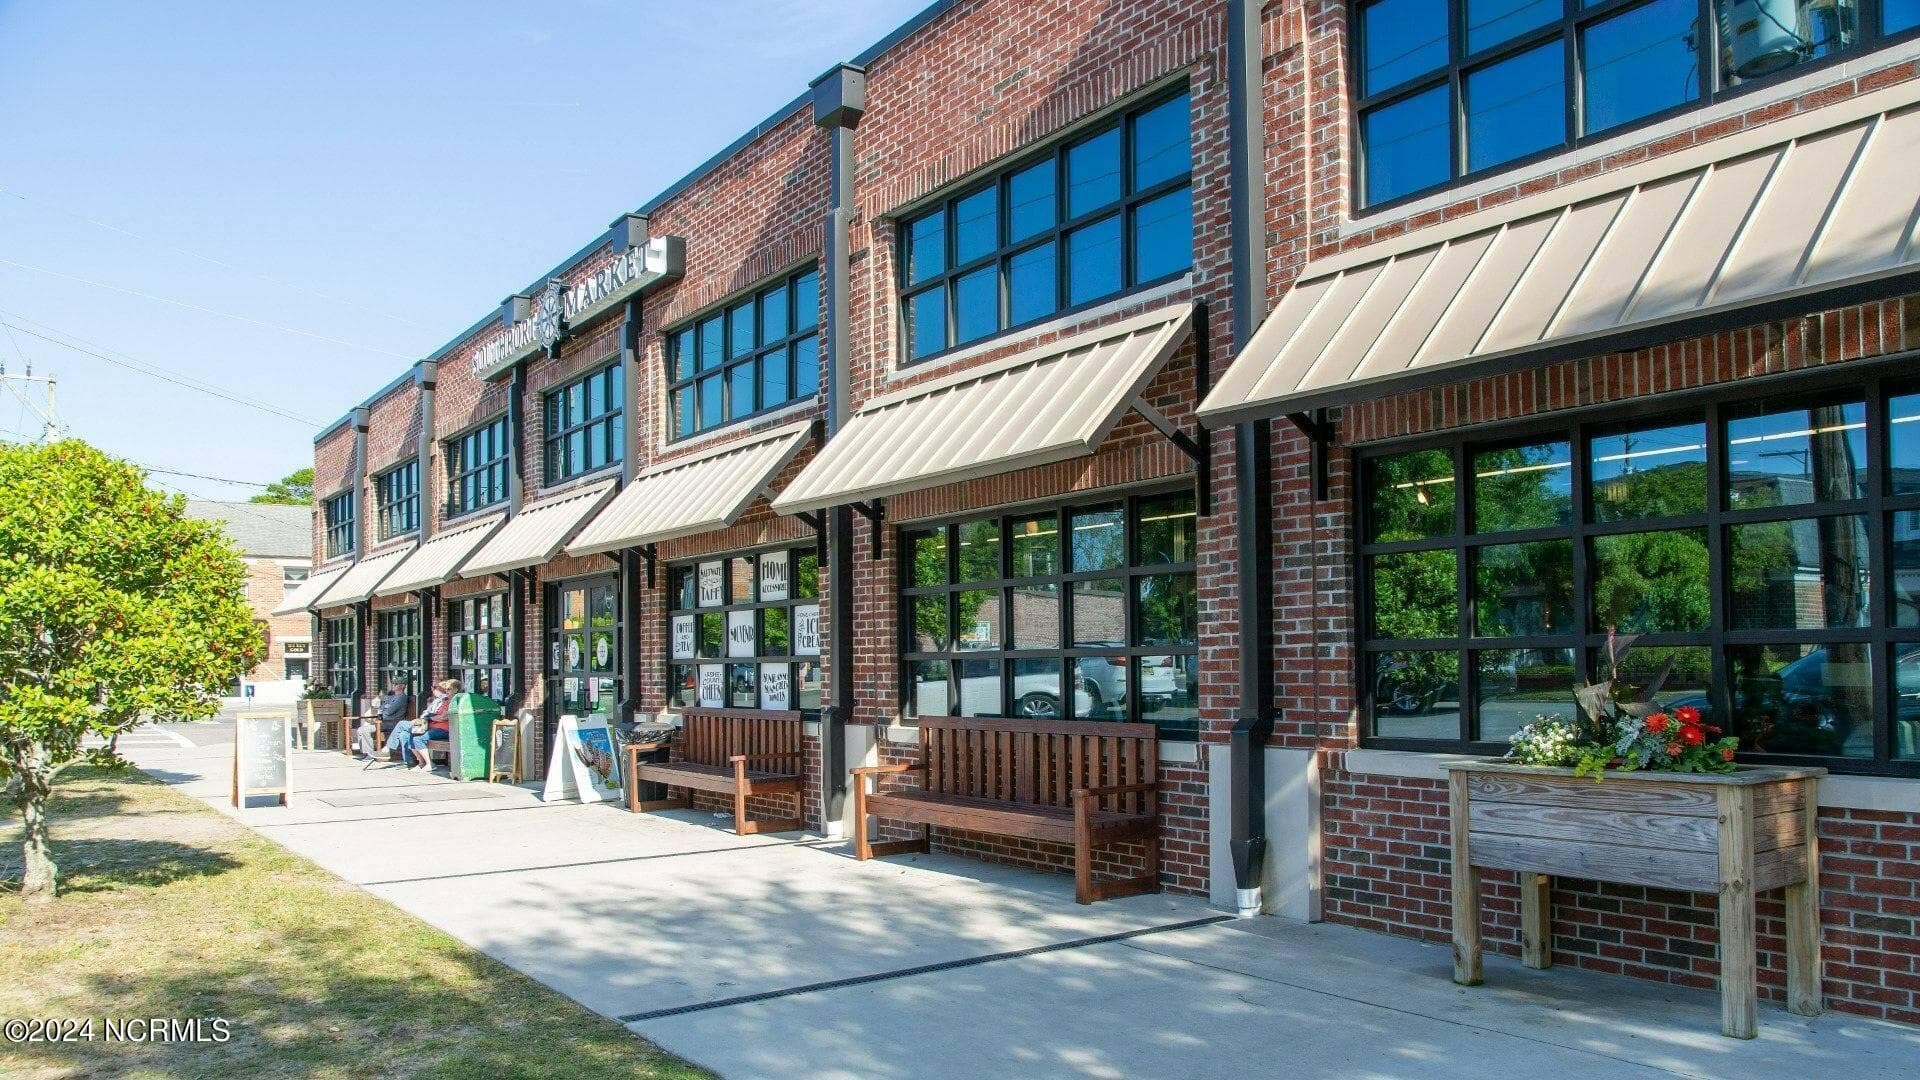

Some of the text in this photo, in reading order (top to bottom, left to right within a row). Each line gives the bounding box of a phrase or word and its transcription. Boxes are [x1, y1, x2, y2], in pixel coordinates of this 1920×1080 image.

[472, 239, 651, 376] SOUTHPORT MARKET
[701, 586, 722, 601] TAFF
[802, 635, 821, 648] CREA
